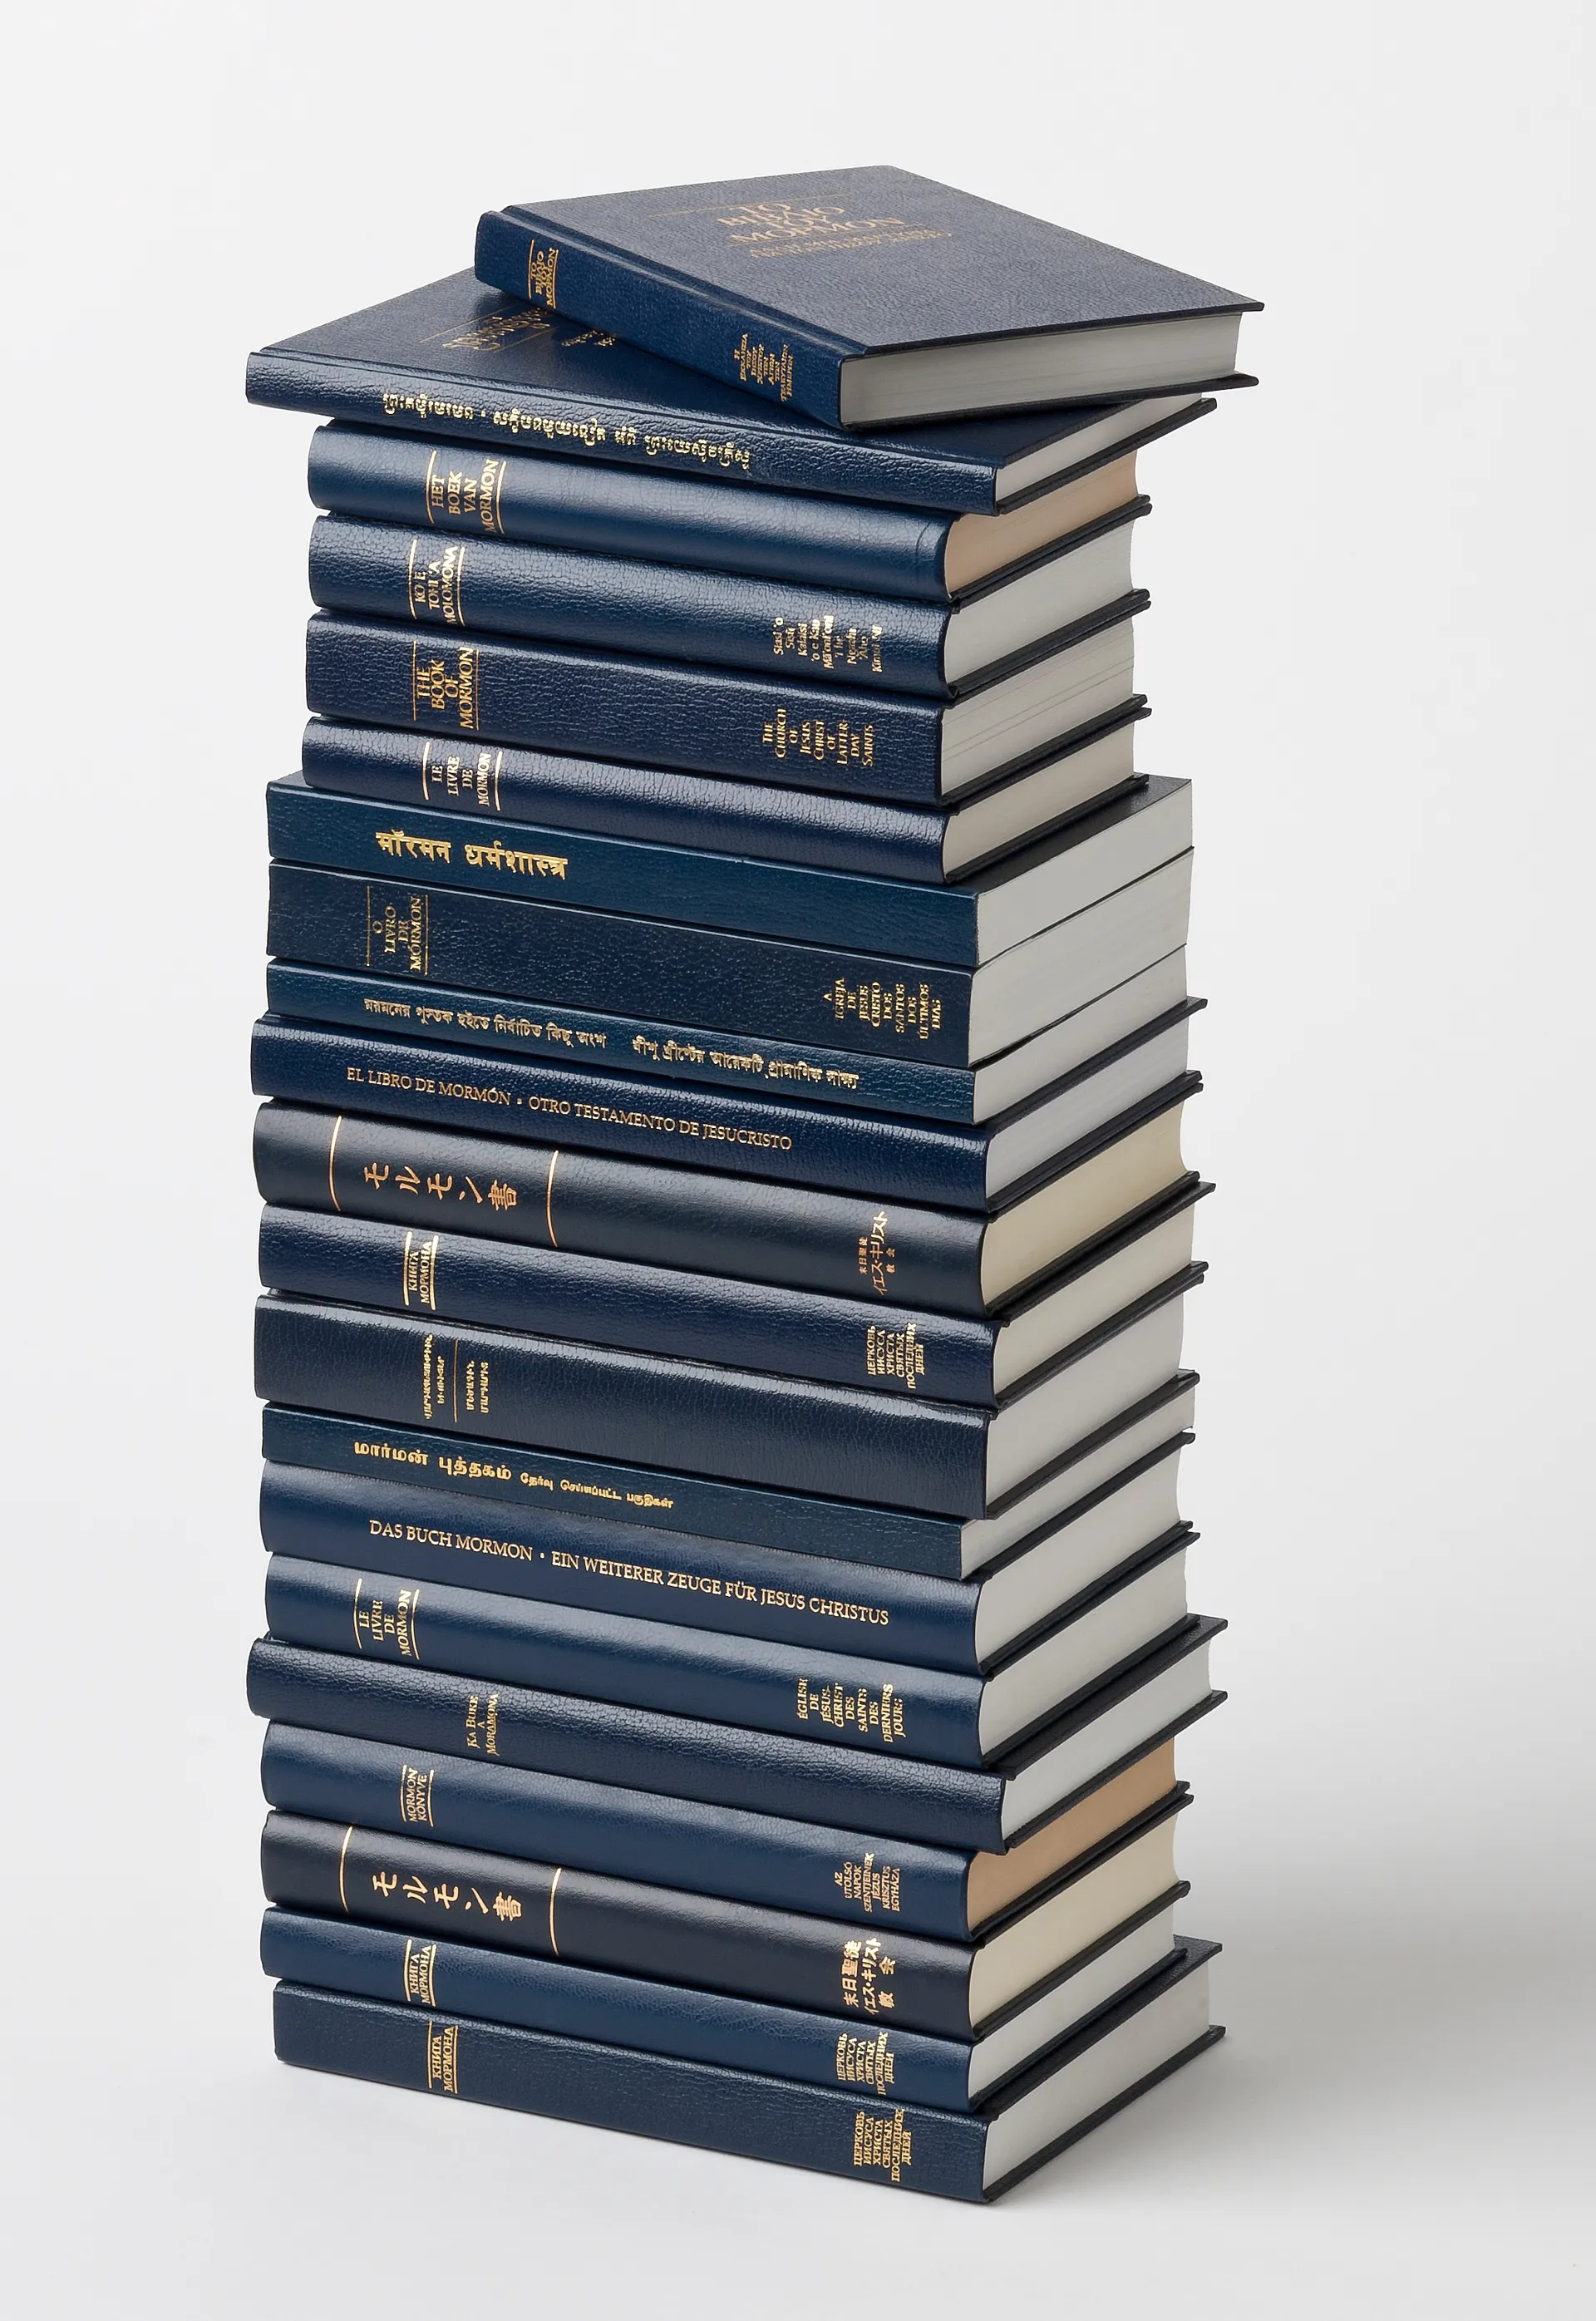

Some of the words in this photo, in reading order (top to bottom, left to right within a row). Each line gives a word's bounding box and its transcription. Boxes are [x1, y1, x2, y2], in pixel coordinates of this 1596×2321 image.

[431, 474, 445, 508] HET
[447, 471, 463, 515] BOEK
[463, 477, 477, 513] VAN
[479, 459, 499, 533] MORMON
[414, 572, 426, 580] E
[414, 584, 426, 603] KO
[428, 579, 440, 609] TOHI
[416, 666, 431, 698] THE
[431, 659, 446, 710] BOOK
[445, 674, 459, 697] OF
[459, 646, 474, 729] MORMON
[762, 722, 773, 743] THE
[775, 708, 786, 758] CHURCH
[789, 728, 798, 744] OF
[799, 721, 811, 754] JESUS
[813, 720, 825, 761] CHRIST
[826, 735, 835, 750] OF
[850, 733, 860, 757] DAY
[862, 724, 873, 766] SAINTS
[431, 765, 443, 783] LE
[446, 756, 460, 796] LIVRE
[461, 769, 473, 789] DE
[476, 752, 491, 806] MORMON
[376, 829, 452, 864] मॉरमन
[372, 920, 383, 934] O
[384, 905, 397, 953] LIVRO
[398, 920, 409, 942] DE
[407, 895, 422, 971] MÓRMON
[823, 993, 832, 1002] A
[835, 978, 846, 1019] IGREJA
[847, 991, 856, 1010] DE
[859, 985, 870, 1021] JESUS
[871, 982, 881, 1027] CRISTO
[883, 993, 893, 1019] DOS
[895, 983, 905, 1033] SANTOS
[908, 997, 917, 1024] DOS
[932, 999, 941, 1029] DIAS
[347, 1067, 364, 1082] EL
[367, 1070, 411, 1089] LIBRO
[415, 1077, 436, 1093] DE
[438, 1081, 511, 1106] MORMÓN
[528, 1096, 571, 1115] OTRO
[574, 1103, 676, 1132] TESTAMENTO
[678, 1120, 700, 1136] DE
[702, 1123, 792, 1151] JESUCRISTO
[363, 1162, 518, 1211] モルモン書
[408, 1251, 419, 1291] КНИГА
[420, 1241, 432, 1303] МОРМОНА
[867, 1325, 876, 1376] ЦЕРКОВЬ
[876, 1330, 885, 1374] ИИСУСА
[886, 1333, 895, 1375] ХРИСТА
[896, 1333, 904, 1377] СВЯТЫХ
[905, 1323, 917, 1389] ПОСЛЕДНИХ
[354, 1441, 428, 1466] மார்மன்
[439, 1456, 511, 1480] புத்தகம்
[369, 1520, 402, 1539] DAS
[406, 1525, 452, 1547] BUCH
[455, 1534, 533, 1561] MORMON
[551, 1550, 579, 1570] EIN
[583, 1556, 664, 1584] WEITERER
[667, 1572, 722, 1595] ZEUGE
[725, 1581, 757, 1602] FÜR
[760, 1589, 805, 1610] JESUS
[809, 1597, 889, 1625] CHRISTUS
[359, 1611, 369, 1628] LE
[372, 1599, 383, 1641] LIVRE
[384, 1614, 395, 1634] DE
[397, 1589, 411, 1656] MORMON
[810, 1693, 819, 1710] DE
[834, 1683, 845, 1727] CHRIST
[845, 1697, 855, 1720] DES
[857, 1688, 868, 1732] SAINTS
[869, 1702, 879, 1725] DES
[882, 1683, 894, 1742] DERNIERS
[894, 1698, 906, 1737] JOURS
[406, 1767, 418, 1822] MORMON
[372, 1870, 522, 1922] モルモン書
[835, 1872, 843, 1886] AZ
[854, 1865, 862, 1900] NAPOK
[863, 1853, 874, 1912] SZENTJEINEK
[882, 1865, 890, 1910] KRISZTUS
[409, 1954, 420, 1994] КНИГА
[419, 1945, 431, 2004] МОРМОНА
[432, 2036, 441, 2080] КНИГА
[443, 2026, 454, 2092] МОРМОНА
[854, 2111, 864, 2166] ЦЕРКОВЬ
[864, 2116, 874, 2165] ИИСУСА
[873, 2119, 883, 2166] ХРИСТА
[883, 2119, 893, 2168] СВЯТЫХ
[891, 2109, 904, 2182] ПОСЛЕДНИХ
[902, 2131, 911, 2166] ДНЕЙ
